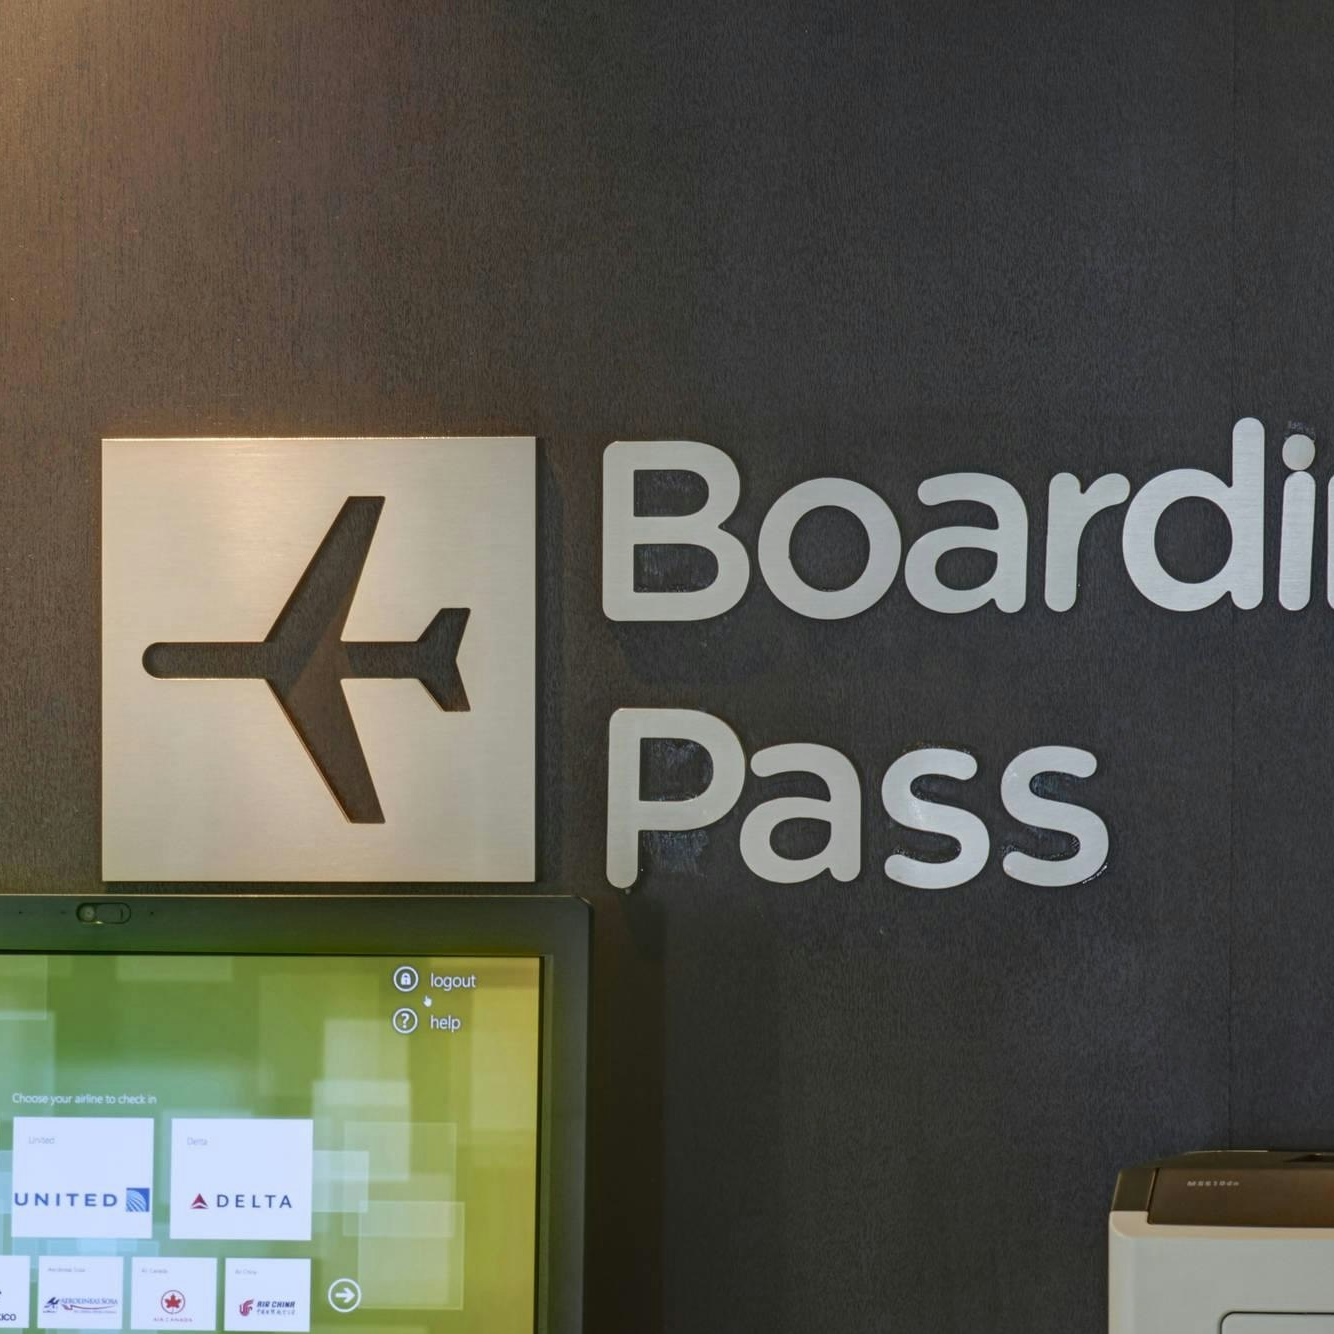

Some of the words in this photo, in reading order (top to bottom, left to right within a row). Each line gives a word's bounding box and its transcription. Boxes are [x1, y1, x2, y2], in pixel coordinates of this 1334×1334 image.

[605, 707, 1111, 890] Pass
[430, 972, 477, 991] logout
[430, 1014, 461, 1033] help
[12, 1092, 48, 1104] Choose
[50, 1095, 73, 1106] your
[75, 1094, 103, 1104] airline
[105, 1095, 116, 1104] to
[118, 1094, 146, 1104] check
[147, 1095, 157, 1104] in
[28, 1136, 55, 1144] United
[187, 1137, 208, 1146] Delta
[14, 1193, 118, 1207] UNITED
[216, 1194, 293, 1209] DELTA
